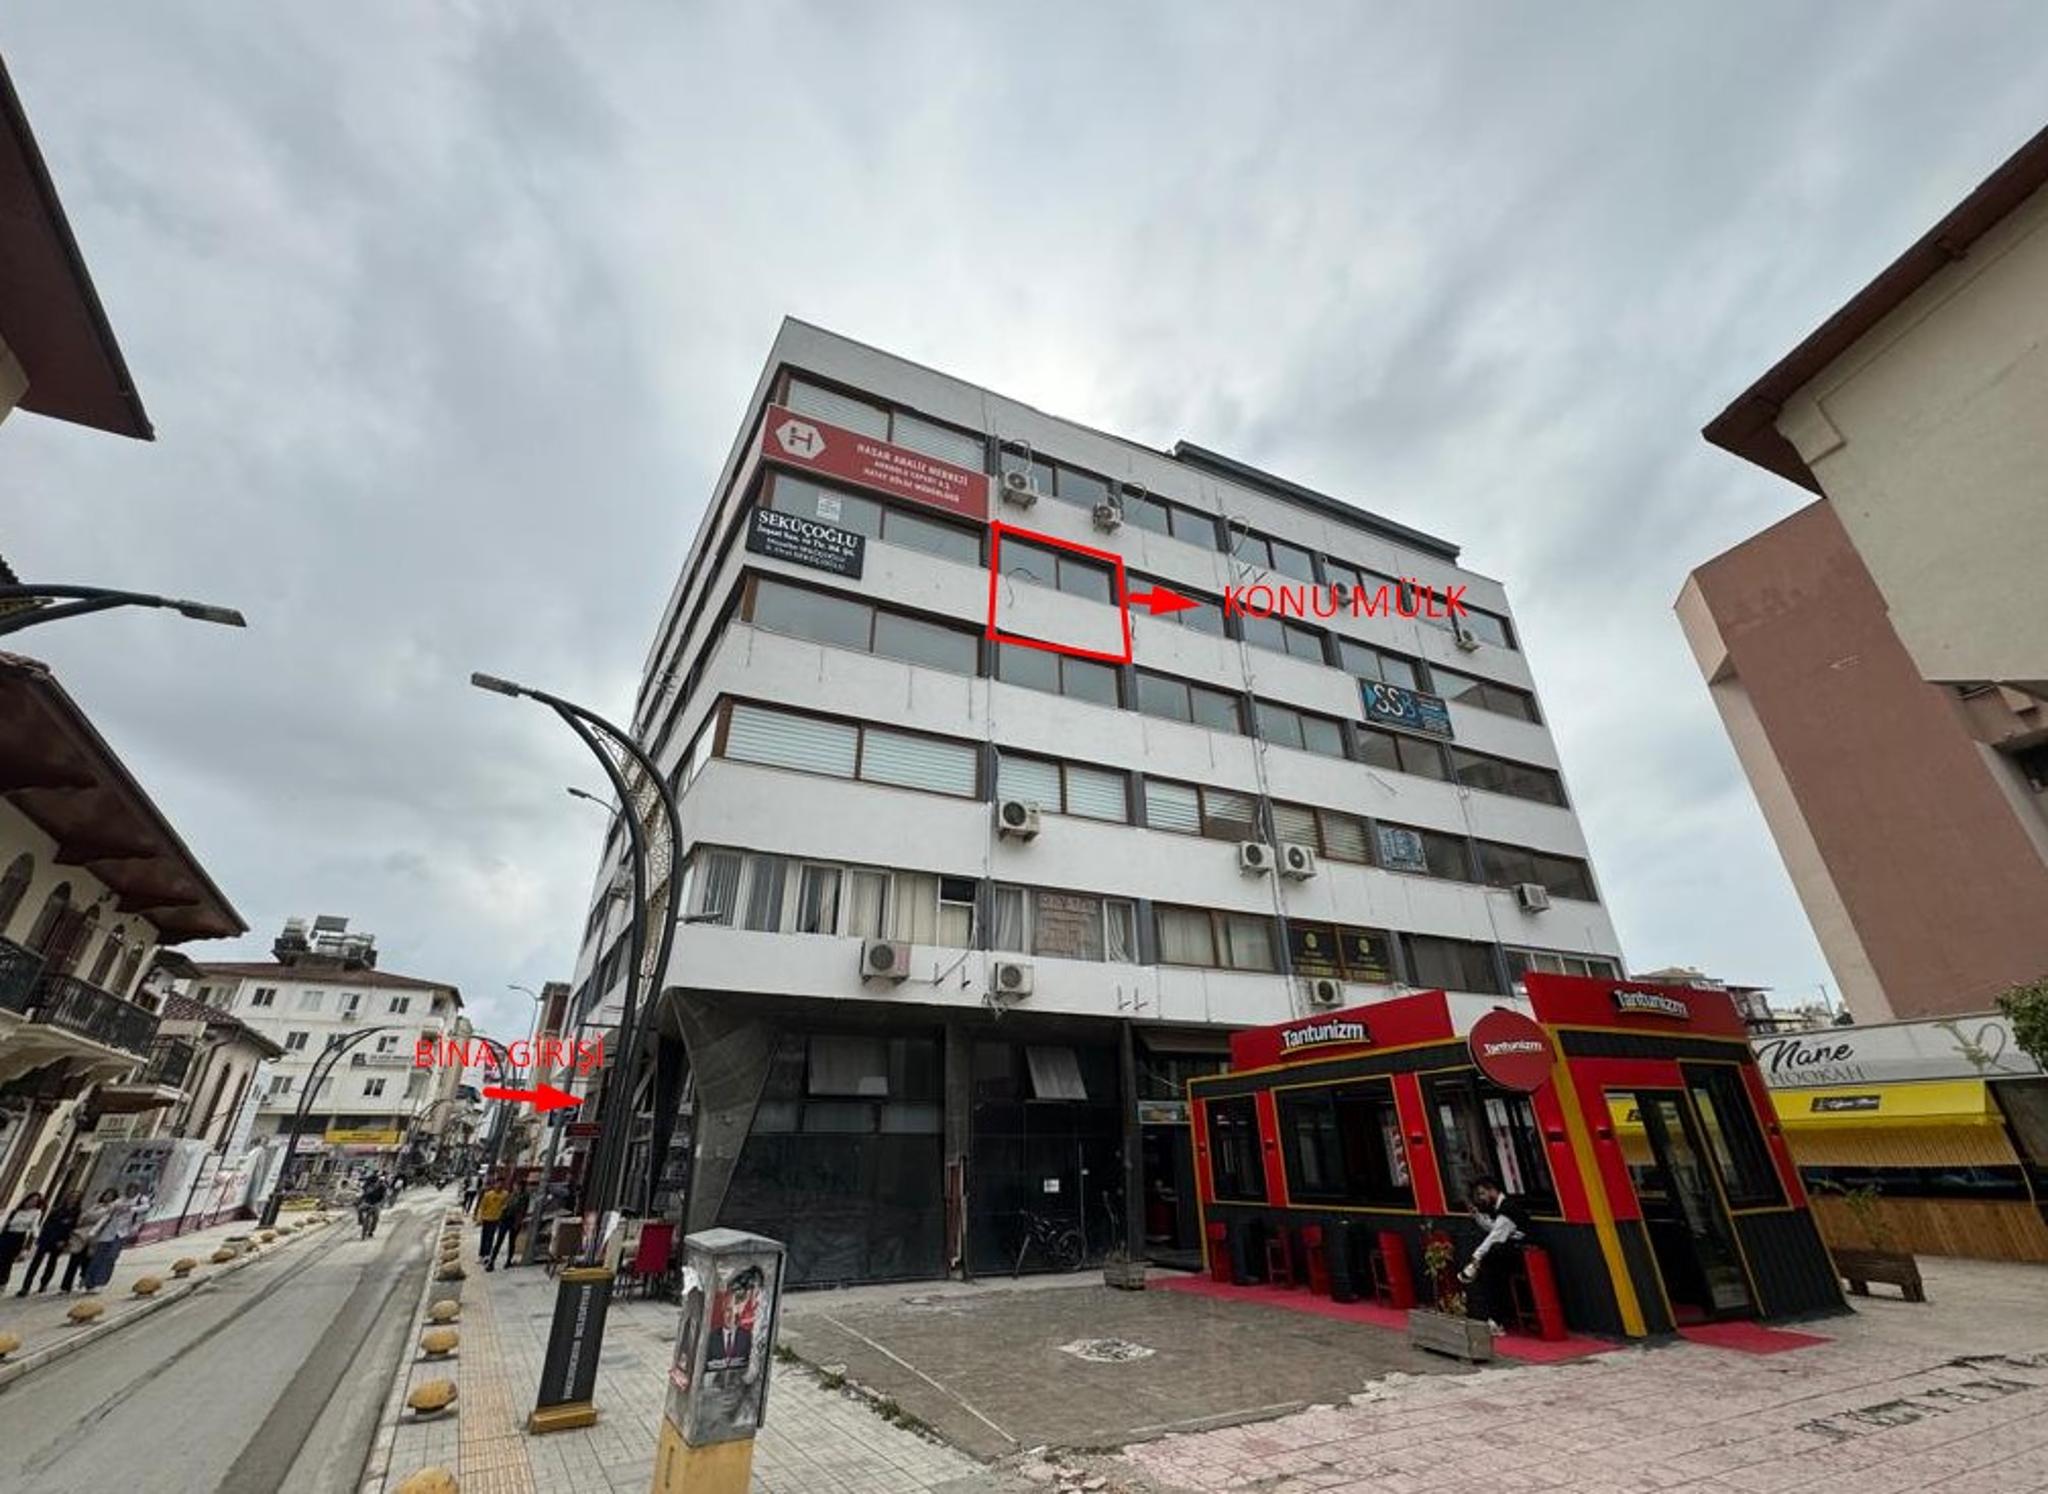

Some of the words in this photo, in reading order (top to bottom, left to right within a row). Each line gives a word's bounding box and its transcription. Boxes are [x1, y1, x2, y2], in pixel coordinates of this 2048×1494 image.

[759, 510, 858, 548] SEKÜÇOĞLU
[1614, 988, 1690, 1018] Tantunizm
[1282, 1019, 1364, 1048] Tantunizm
